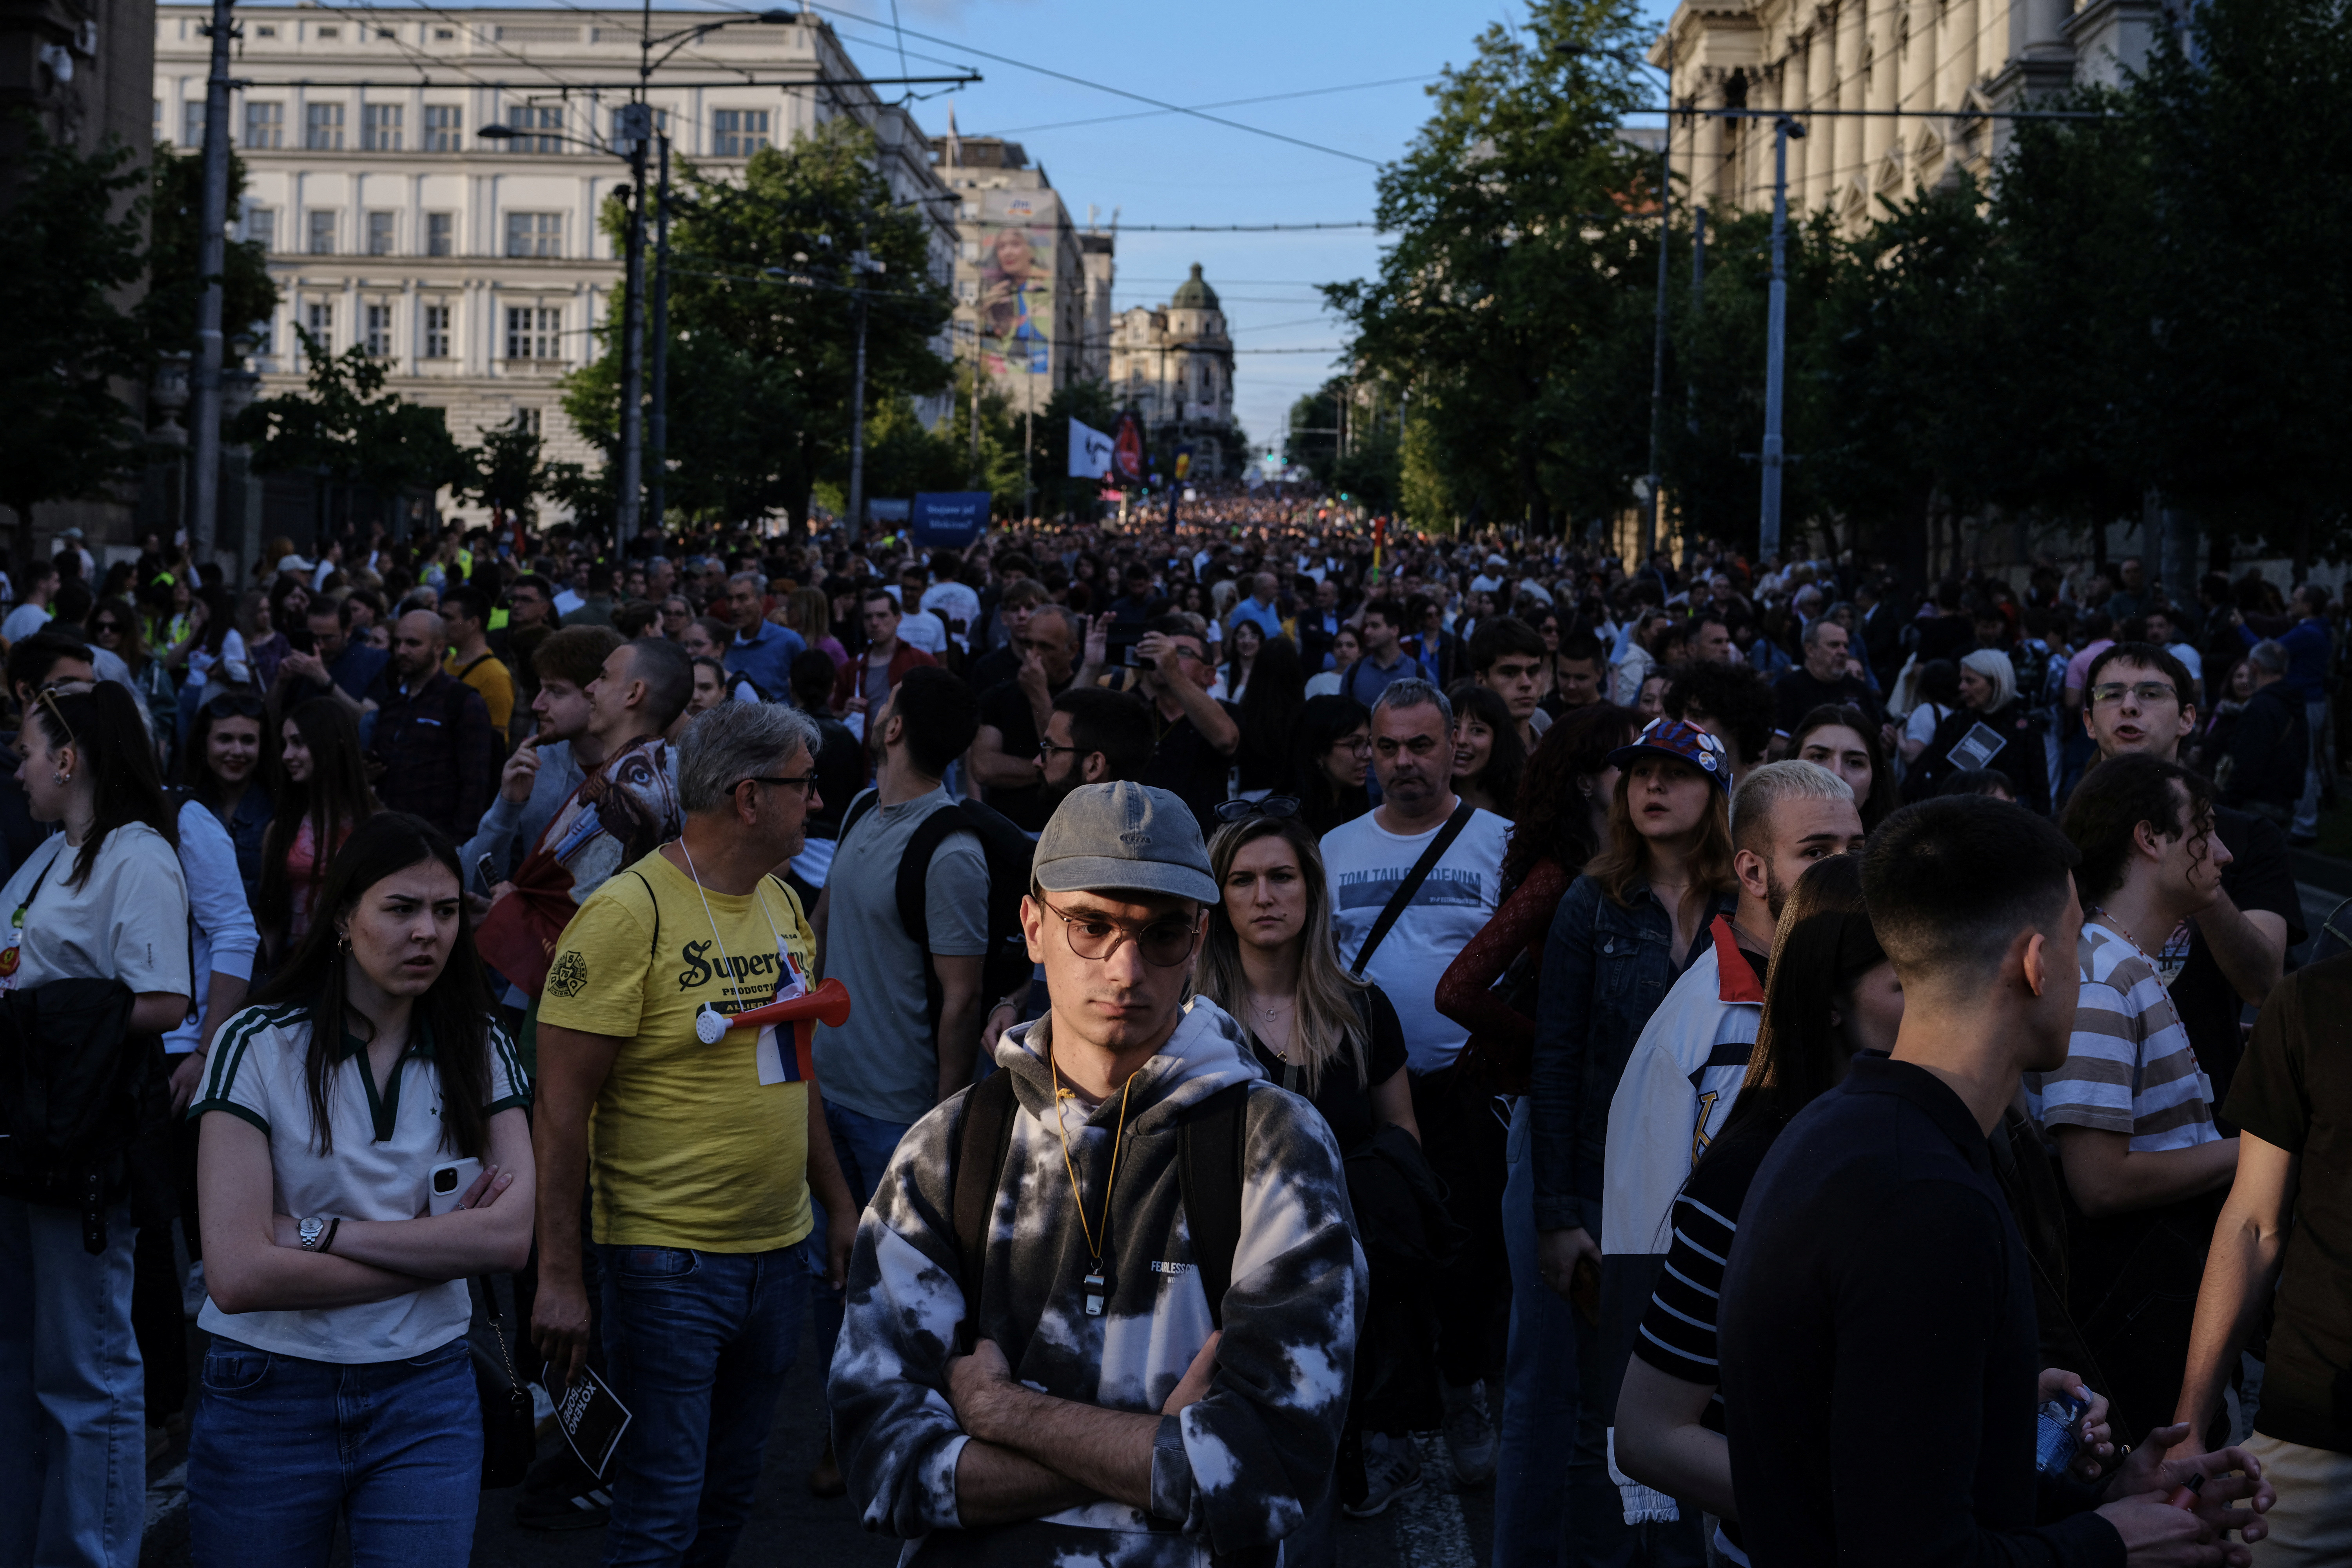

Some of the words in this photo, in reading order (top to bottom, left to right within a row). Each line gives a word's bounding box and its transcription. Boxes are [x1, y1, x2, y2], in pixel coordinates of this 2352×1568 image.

[1339, 870, 1368, 886] TOM
[1430, 869, 1481, 885] DENIM
[568, 1381, 597, 1435] ХОЋЕМО
